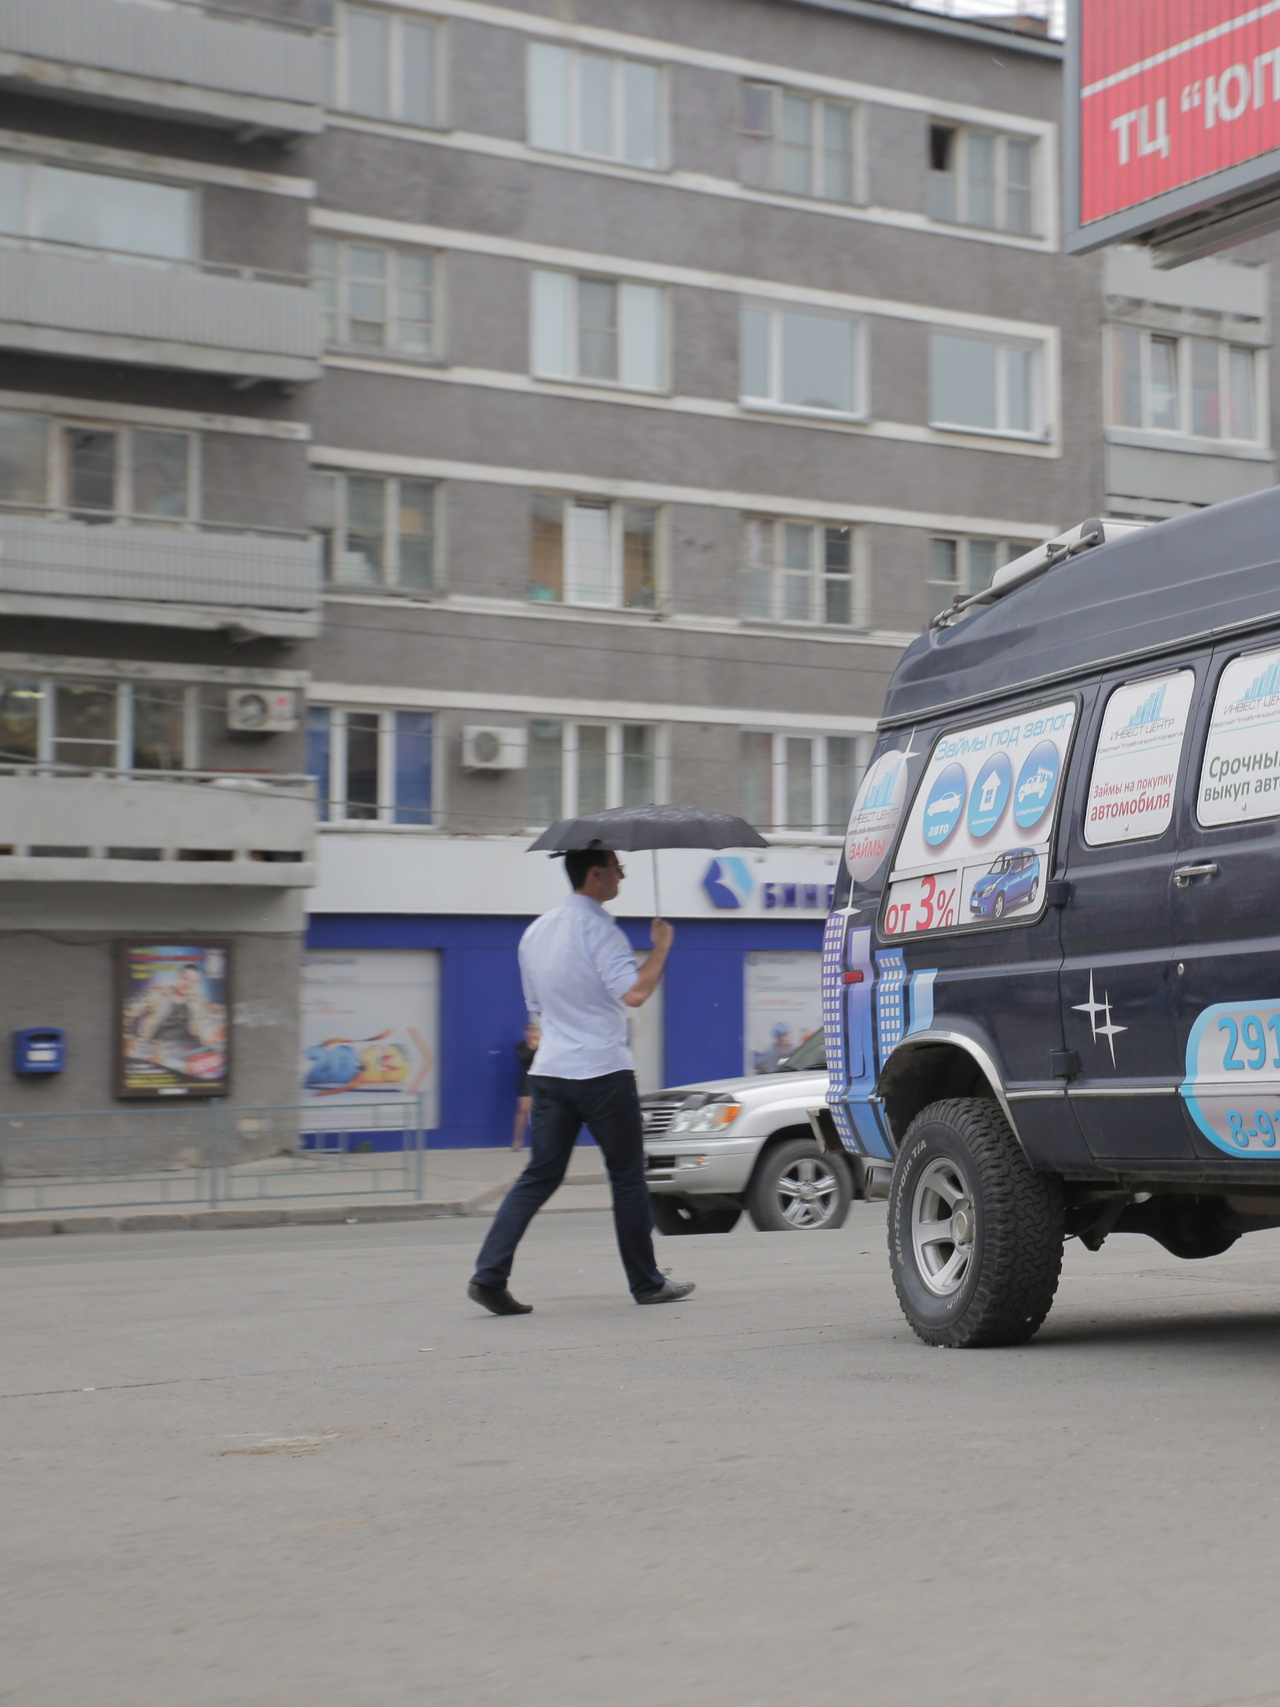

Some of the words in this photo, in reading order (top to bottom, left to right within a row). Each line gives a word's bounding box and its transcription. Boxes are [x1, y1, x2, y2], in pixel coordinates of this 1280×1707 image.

[1110, 97, 1171, 166] ТЦ
[1223, 698, 1262, 716] ИНВЕСТ
[1110, 725, 1145, 741] ИНВЕСТ
[1145, 718, 1175, 734] ЦЕНТР
[934, 738, 987, 762] Займы
[990, 726, 1020, 749] под
[1093, 782, 1122, 799] Займы
[1124, 780, 1135, 792] на
[1137, 773, 1174, 791] покупку
[1204, 781, 1251, 803] выкуп
[1091, 791, 1170, 822] автомобиля
[927, 824, 949, 837] авто
[849, 836, 888, 860] ЗАЙМЫ
[885, 903, 911, 935] от
[911, 1139, 928, 1160] T/A
